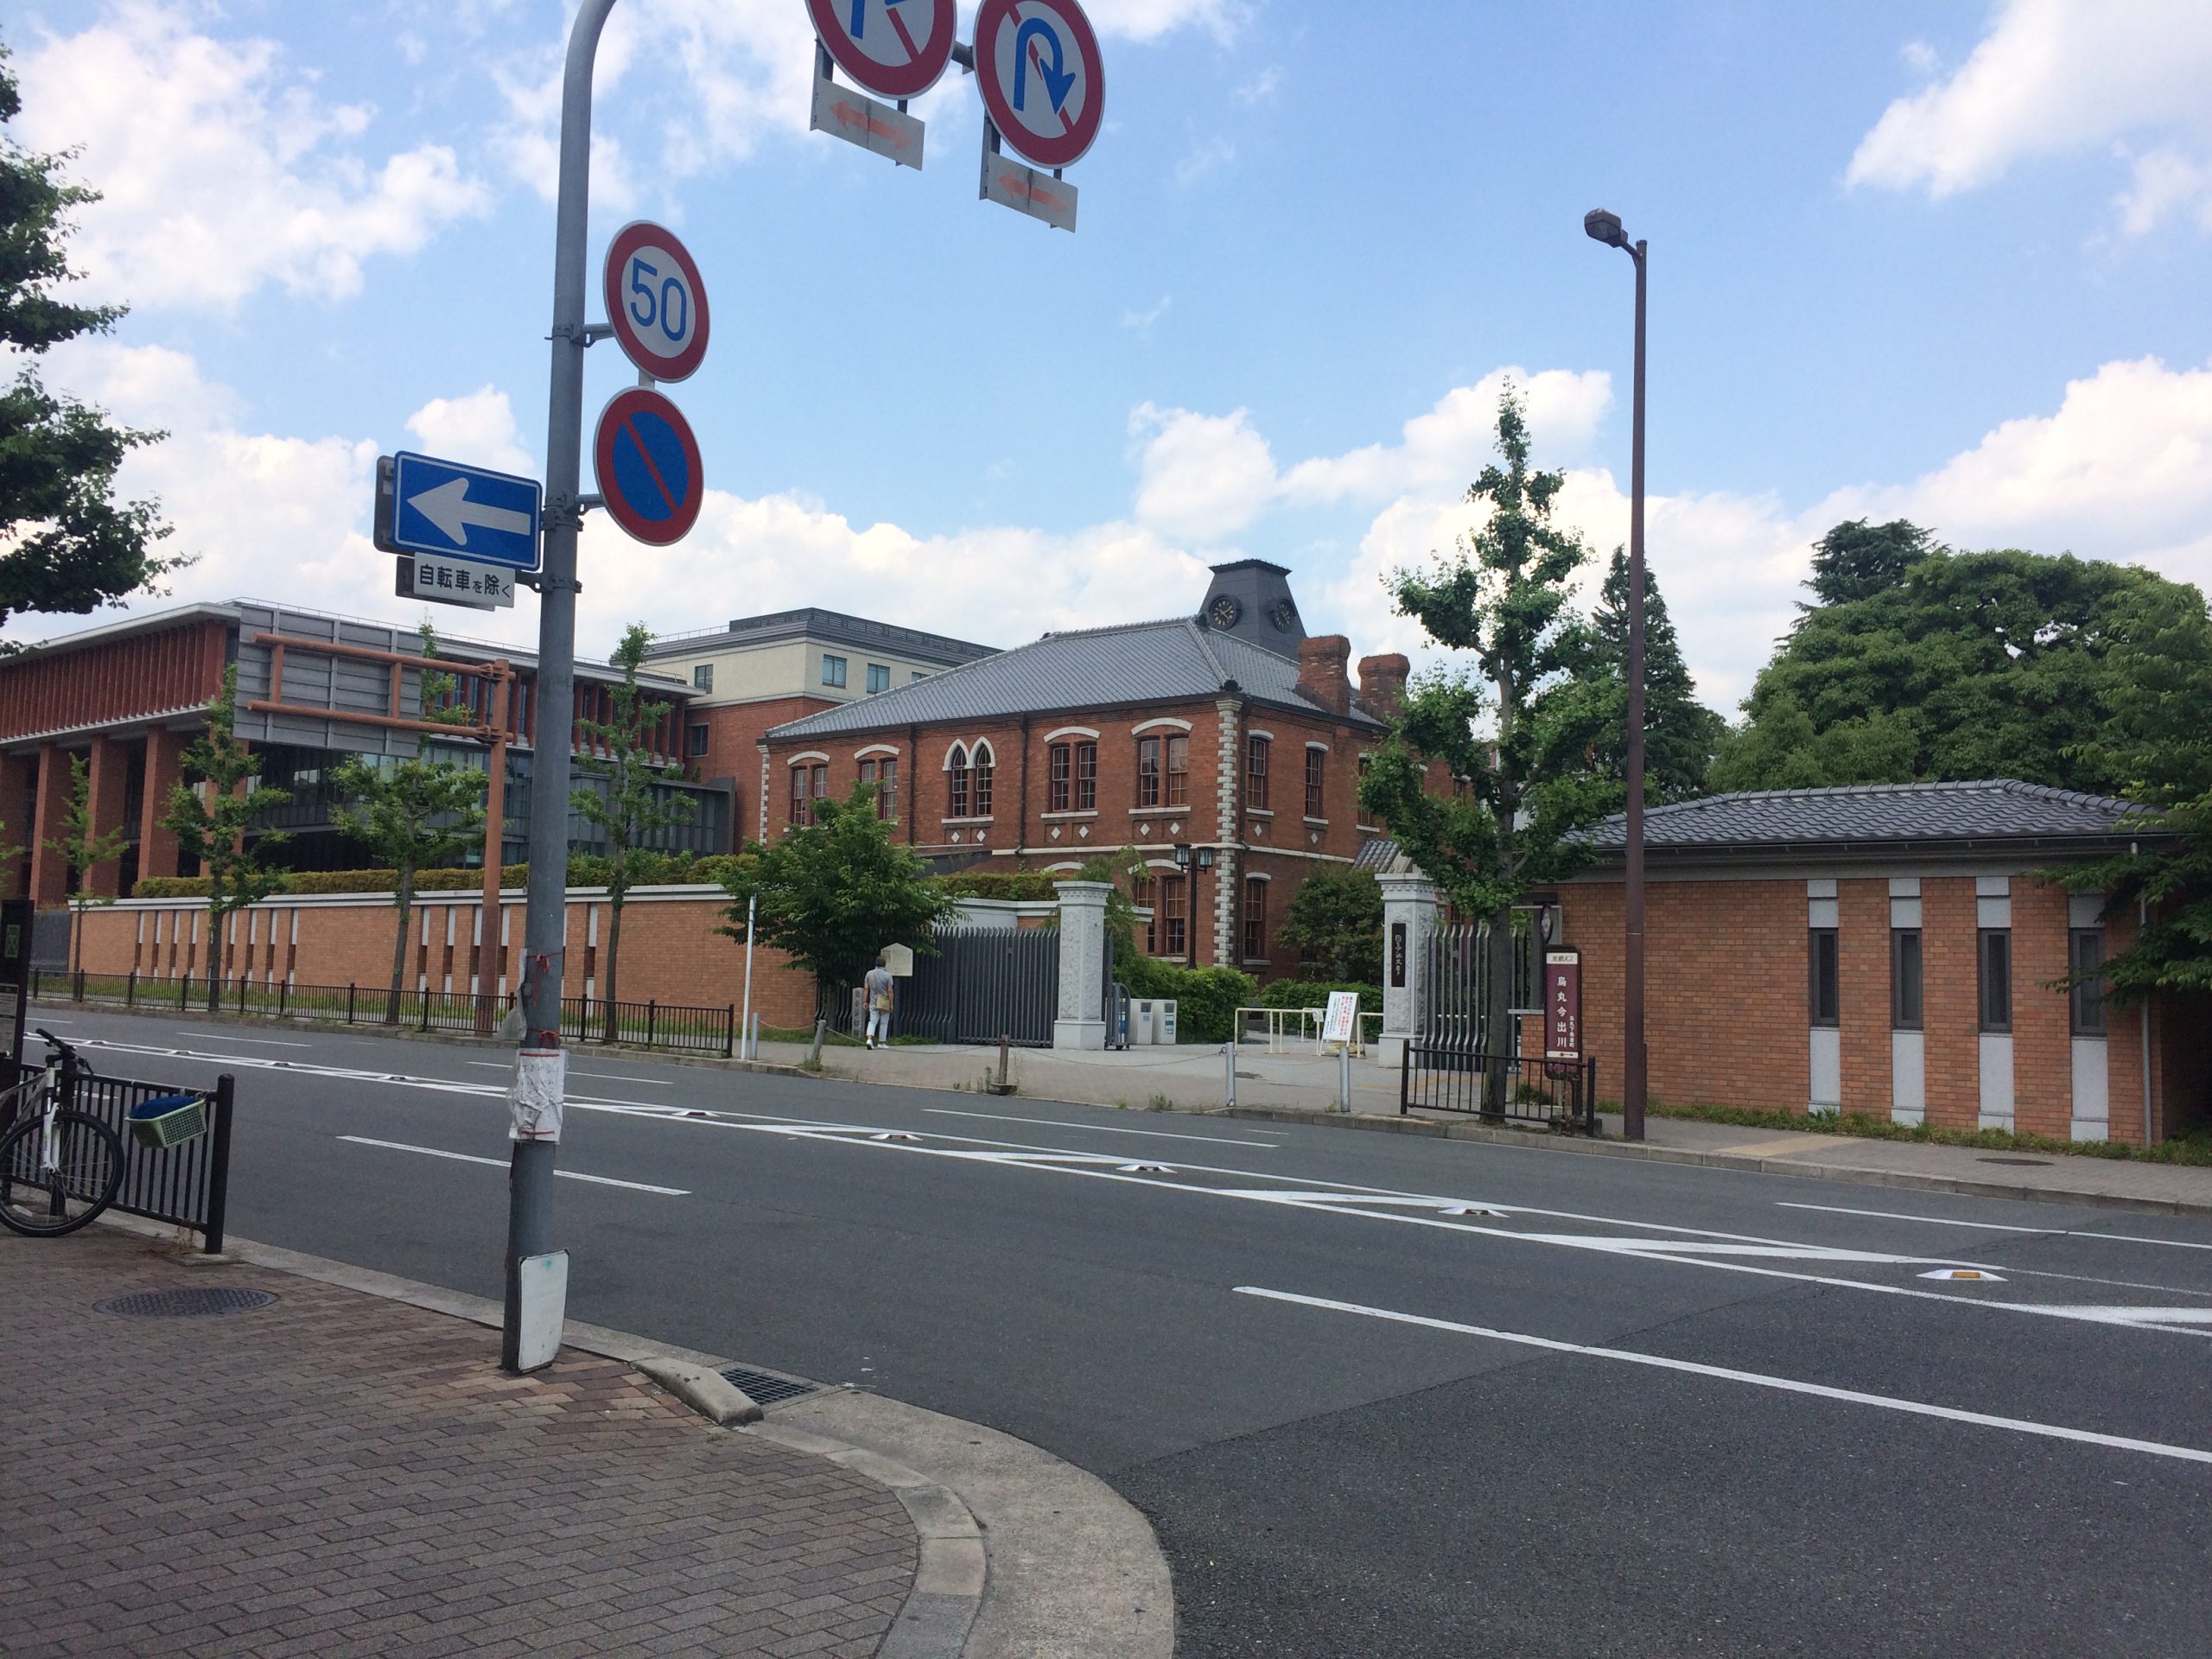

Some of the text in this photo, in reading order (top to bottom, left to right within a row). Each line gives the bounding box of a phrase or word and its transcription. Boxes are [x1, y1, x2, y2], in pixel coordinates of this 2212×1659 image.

[631, 257, 687, 341] 50
[420, 563, 511, 598] 自転車を除く
